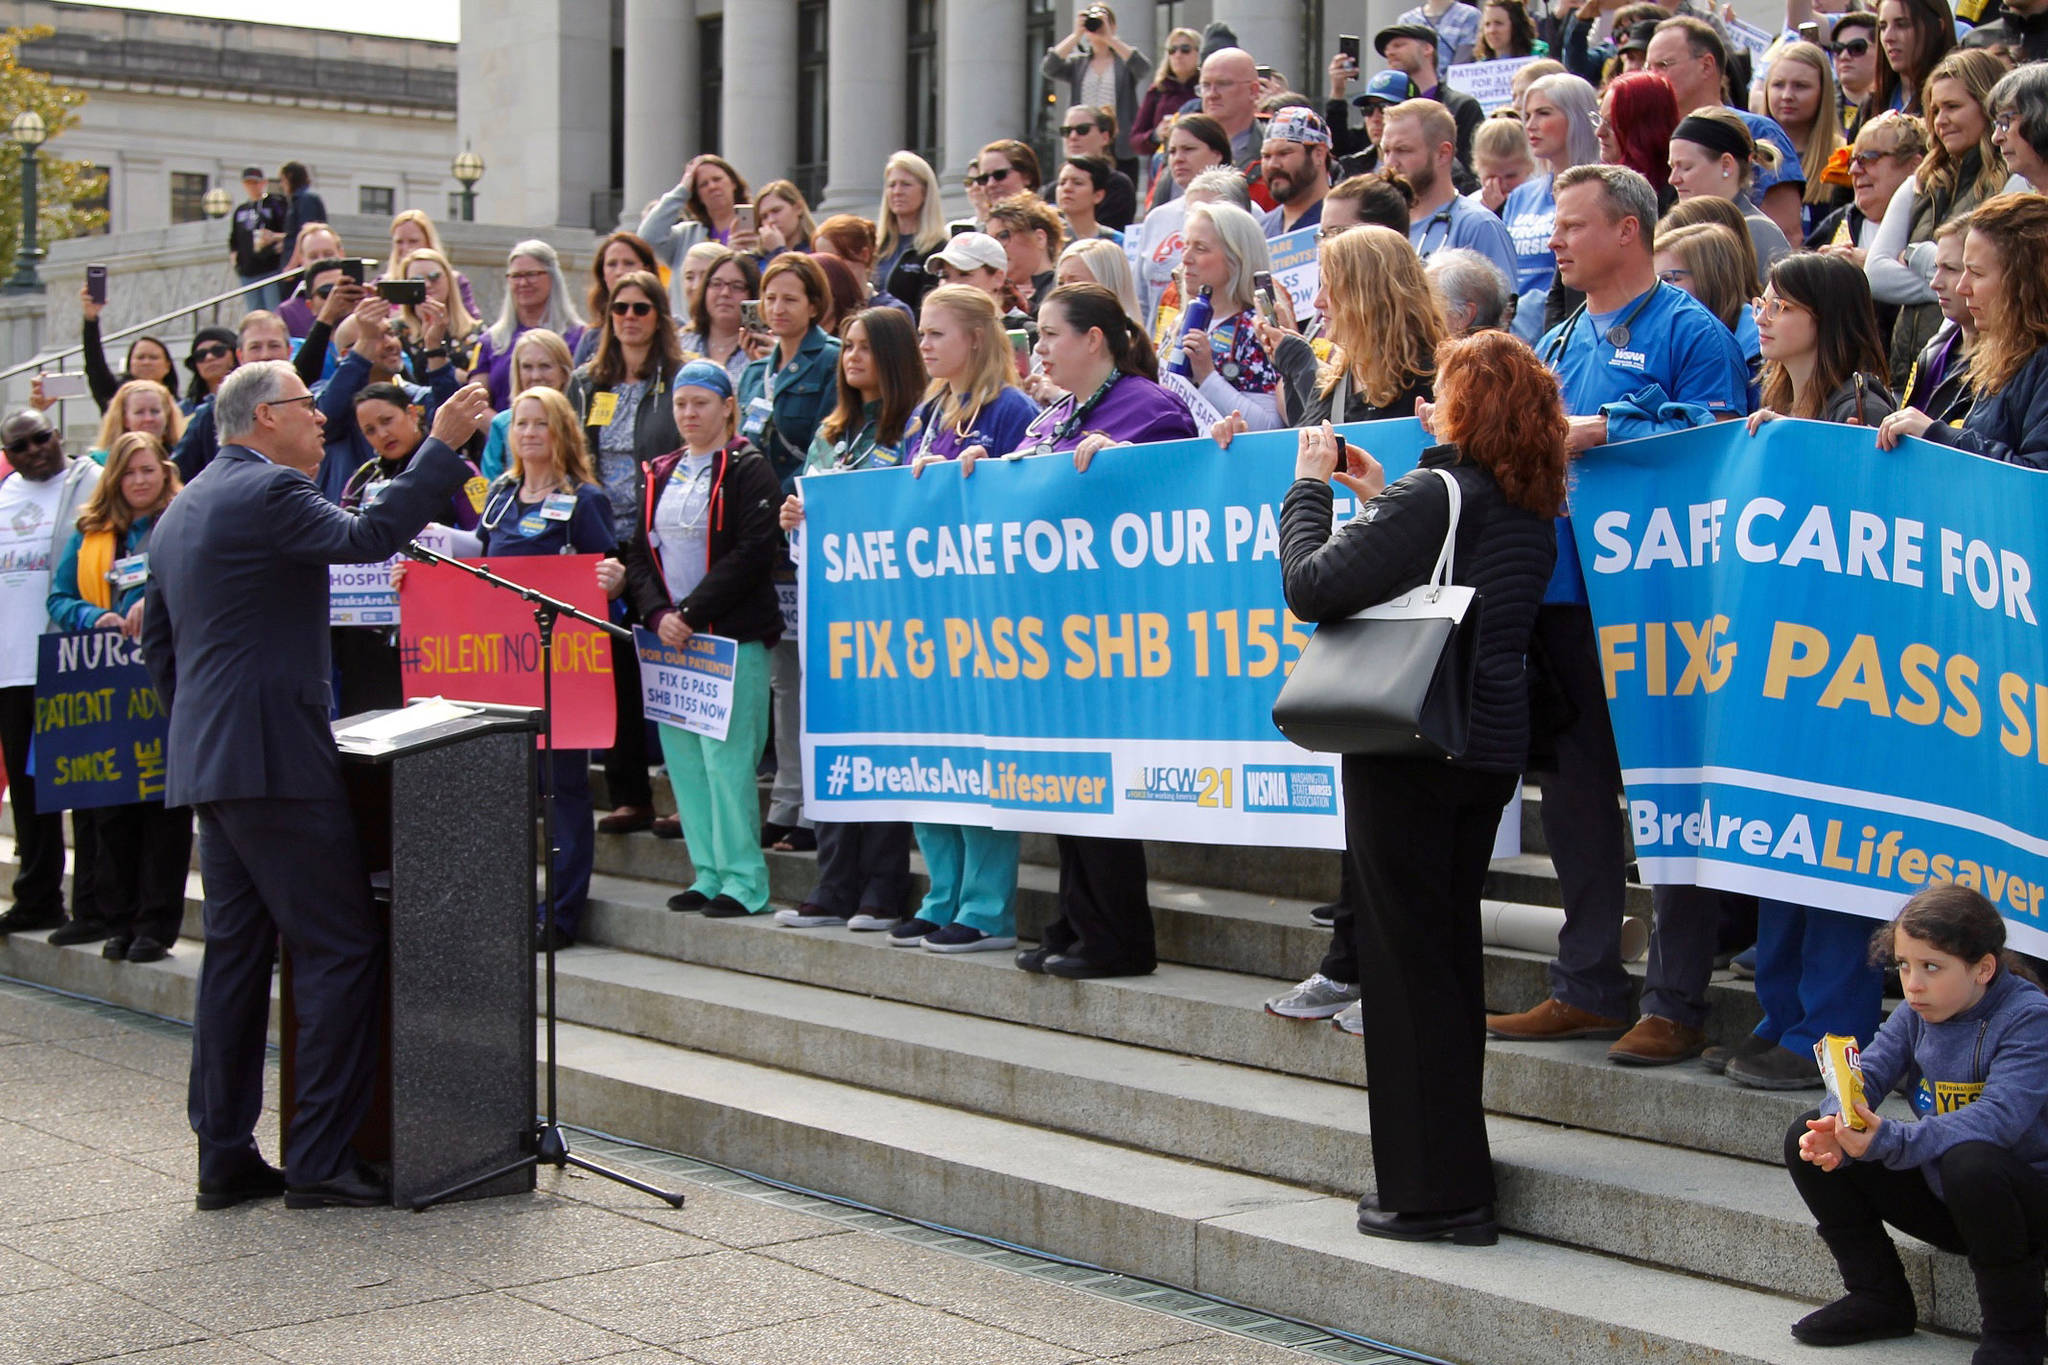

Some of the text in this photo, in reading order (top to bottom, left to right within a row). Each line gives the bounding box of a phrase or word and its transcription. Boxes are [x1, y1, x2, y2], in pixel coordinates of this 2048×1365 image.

[1451, 66, 1495, 78] PATIENT
[1471, 79, 1492, 88] FOR
[1271, 239, 1293, 255] ARE
[1282, 273, 1299, 289] SS
[1291, 286, 1314, 305] OW
[1615, 347, 1646, 363] WSNA
[822, 530, 900, 583] SAFE
[906, 523, 996, 578] CARE
[1002, 517, 1099, 575] FOR
[1110, 508, 1214, 569] OUR
[1592, 496, 2038, 626] SAFE CARE FOR
[329, 572, 391, 587] HOSPIT
[57, 631, 146, 674] NURS
[639, 647, 662, 662] FOR
[663, 651, 687, 666] OUR
[688, 639, 717, 656] CARE
[828, 608, 1310, 681] FIX & PASS SHB 1155
[658, 671, 679, 689] FIX
[692, 679, 719, 699] PASS
[1598, 616, 1714, 700] FIX
[1762, 620, 1983, 738] PASS
[35, 687, 116, 735] PATIENT
[648, 688, 671, 706] SHB
[674, 693, 697, 713] 1155
[699, 700, 728, 722] NOW
[53, 747, 123, 786] SINCE
[133, 737, 166, 801] THE
[1143, 766, 1233, 808] UFCW 21
[1246, 771, 1329, 807] WSNA WASHINGTON
[1292, 796, 1330, 808] ASSOCIATION
